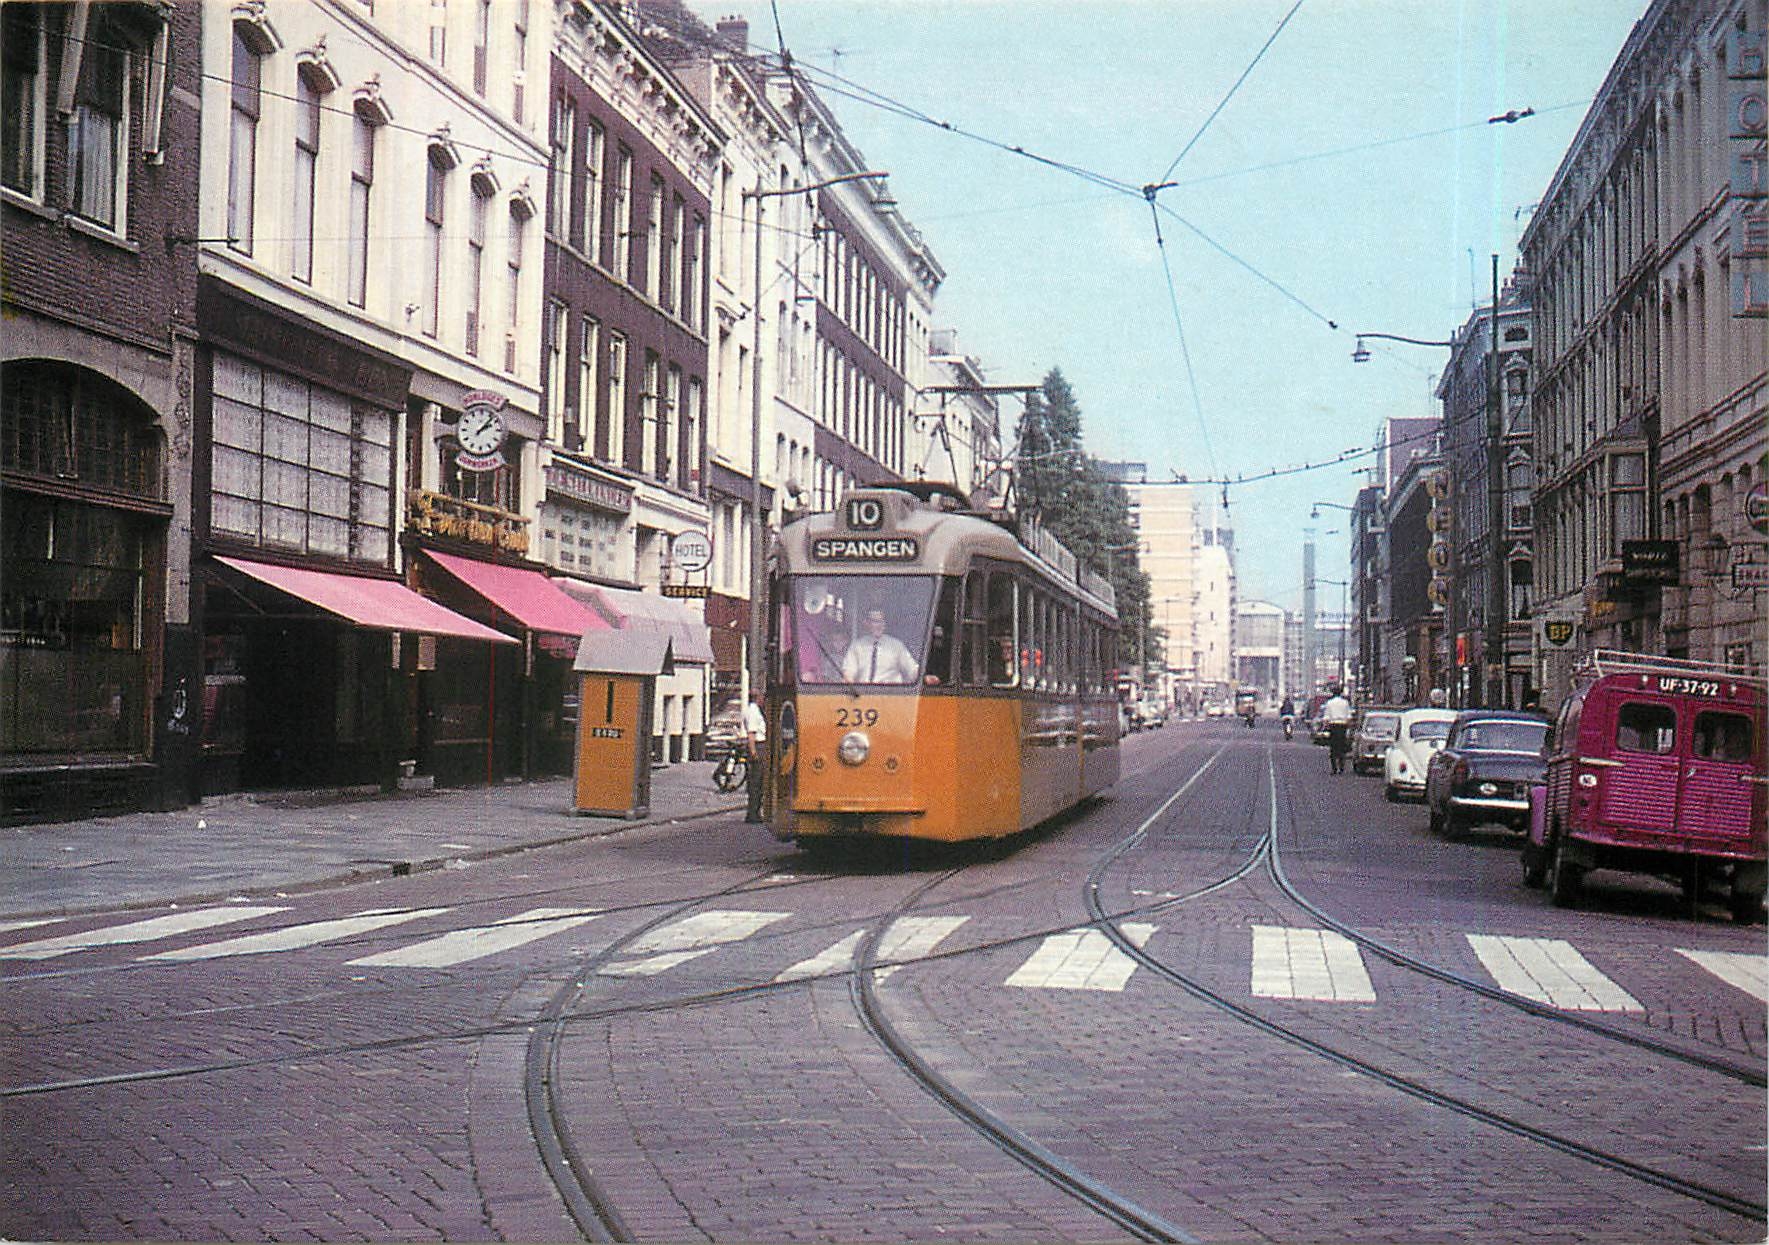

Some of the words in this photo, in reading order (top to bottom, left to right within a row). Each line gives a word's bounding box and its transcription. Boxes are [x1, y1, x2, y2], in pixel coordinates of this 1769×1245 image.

[851, 502, 880, 525] 10
[675, 544, 706, 557] HOTEL
[818, 541, 915, 557] SPANGEN
[1550, 624, 1571, 640] BP
[837, 708, 878, 727] 239
